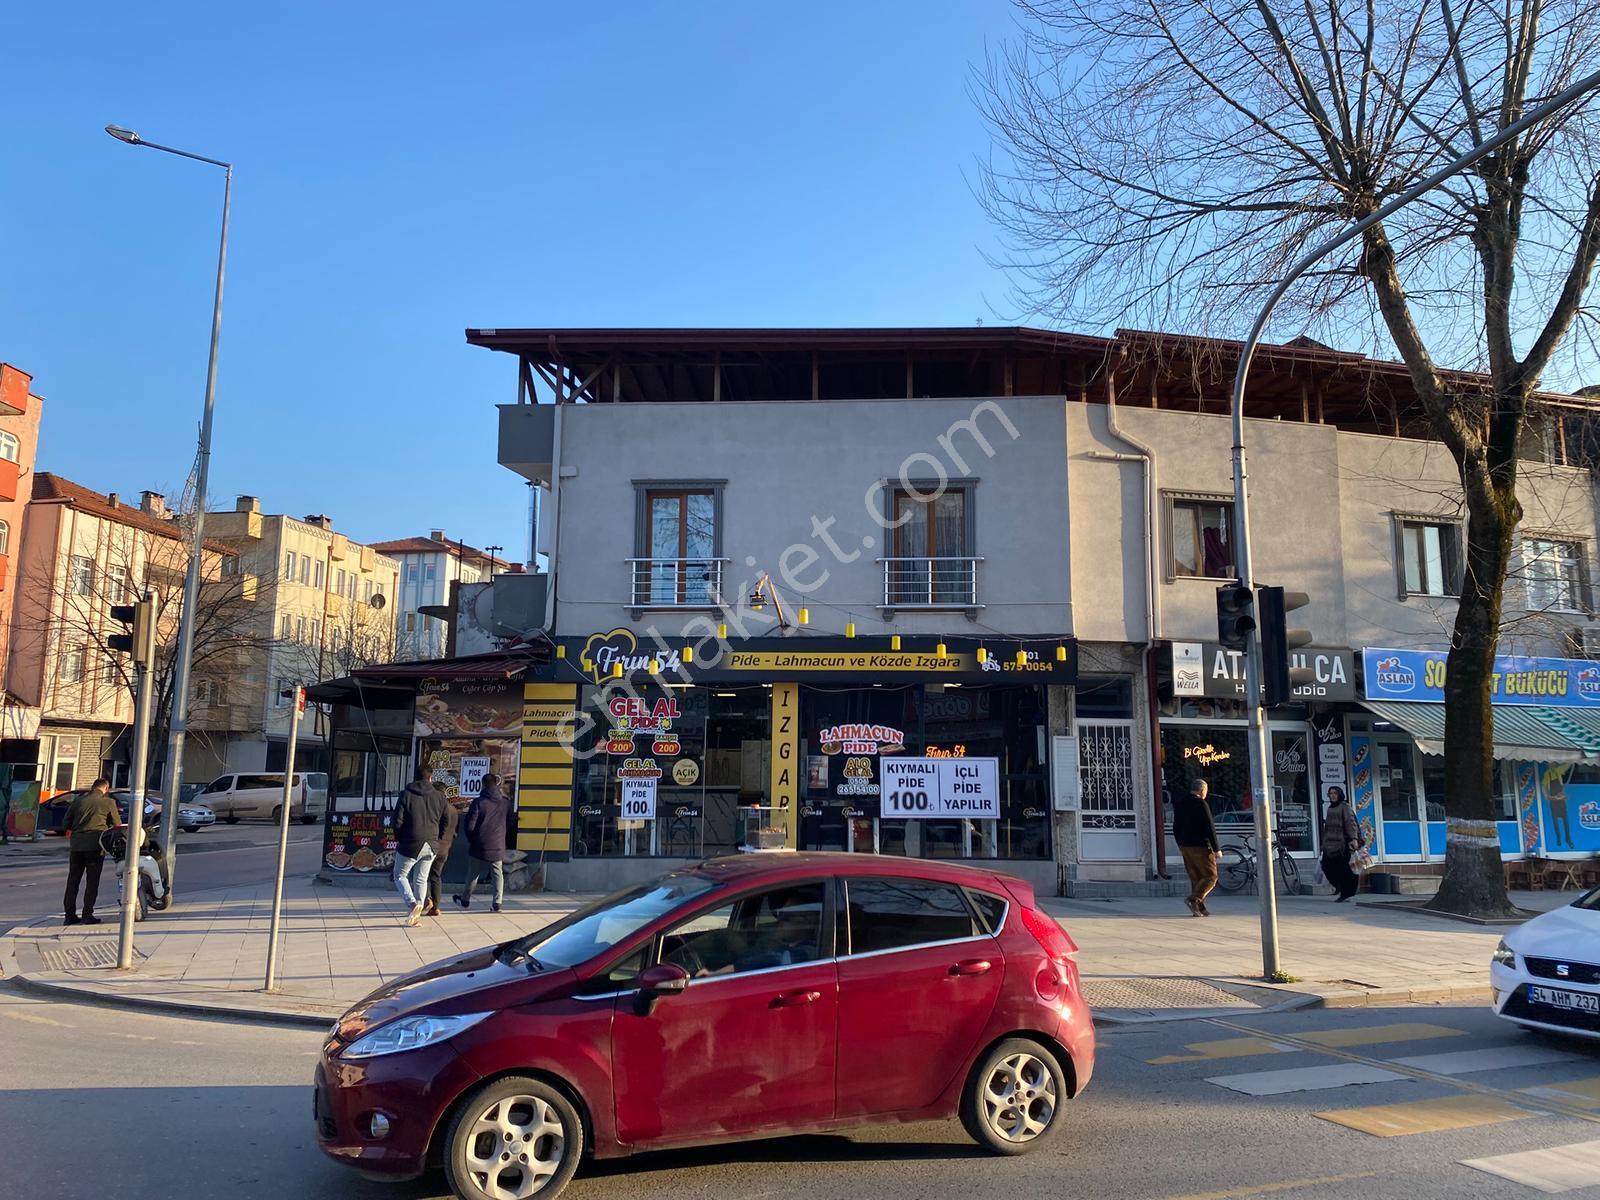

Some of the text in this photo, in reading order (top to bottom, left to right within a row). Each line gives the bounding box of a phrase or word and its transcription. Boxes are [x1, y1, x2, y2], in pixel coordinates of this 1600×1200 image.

[656, 650, 681, 672] 54
[731, 655, 760, 666] Pide
[774, 655, 845, 667] Lahmacun
[850, 658, 866, 667] ve
[870, 655, 911, 667] Közde
[915, 656, 961, 669] Izgara
[1026, 662, 1053, 671] 0054
[1378, 673, 1414, 683] ASLAN
[1177, 681, 1199, 689] WELLA
[1580, 682, 1600, 692] ASL
[523, 709, 575, 718] Lahmacun
[610, 698, 681, 718] GEL AL
[529, 729, 567, 738] Pideler
[820, 725, 903, 743] LAHMACUN
[844, 741, 877, 753] PİDE
[953, 745, 966, 757] 54
[624, 760, 655, 768] GEL AL
[887, 763, 935, 774] KIYMALI
[676, 768, 697, 778] AÇIK
[955, 765, 979, 780] İÇLİ
[626, 780, 654, 788] KIYMALI
[898, 776, 925, 788] PİDE
[631, 789, 647, 798] PİDE
[953, 782, 982, 794] PİDE
[944, 799, 992, 810] YAPILIR
[1533, 986, 1599, 1011] 54 AHM 232
